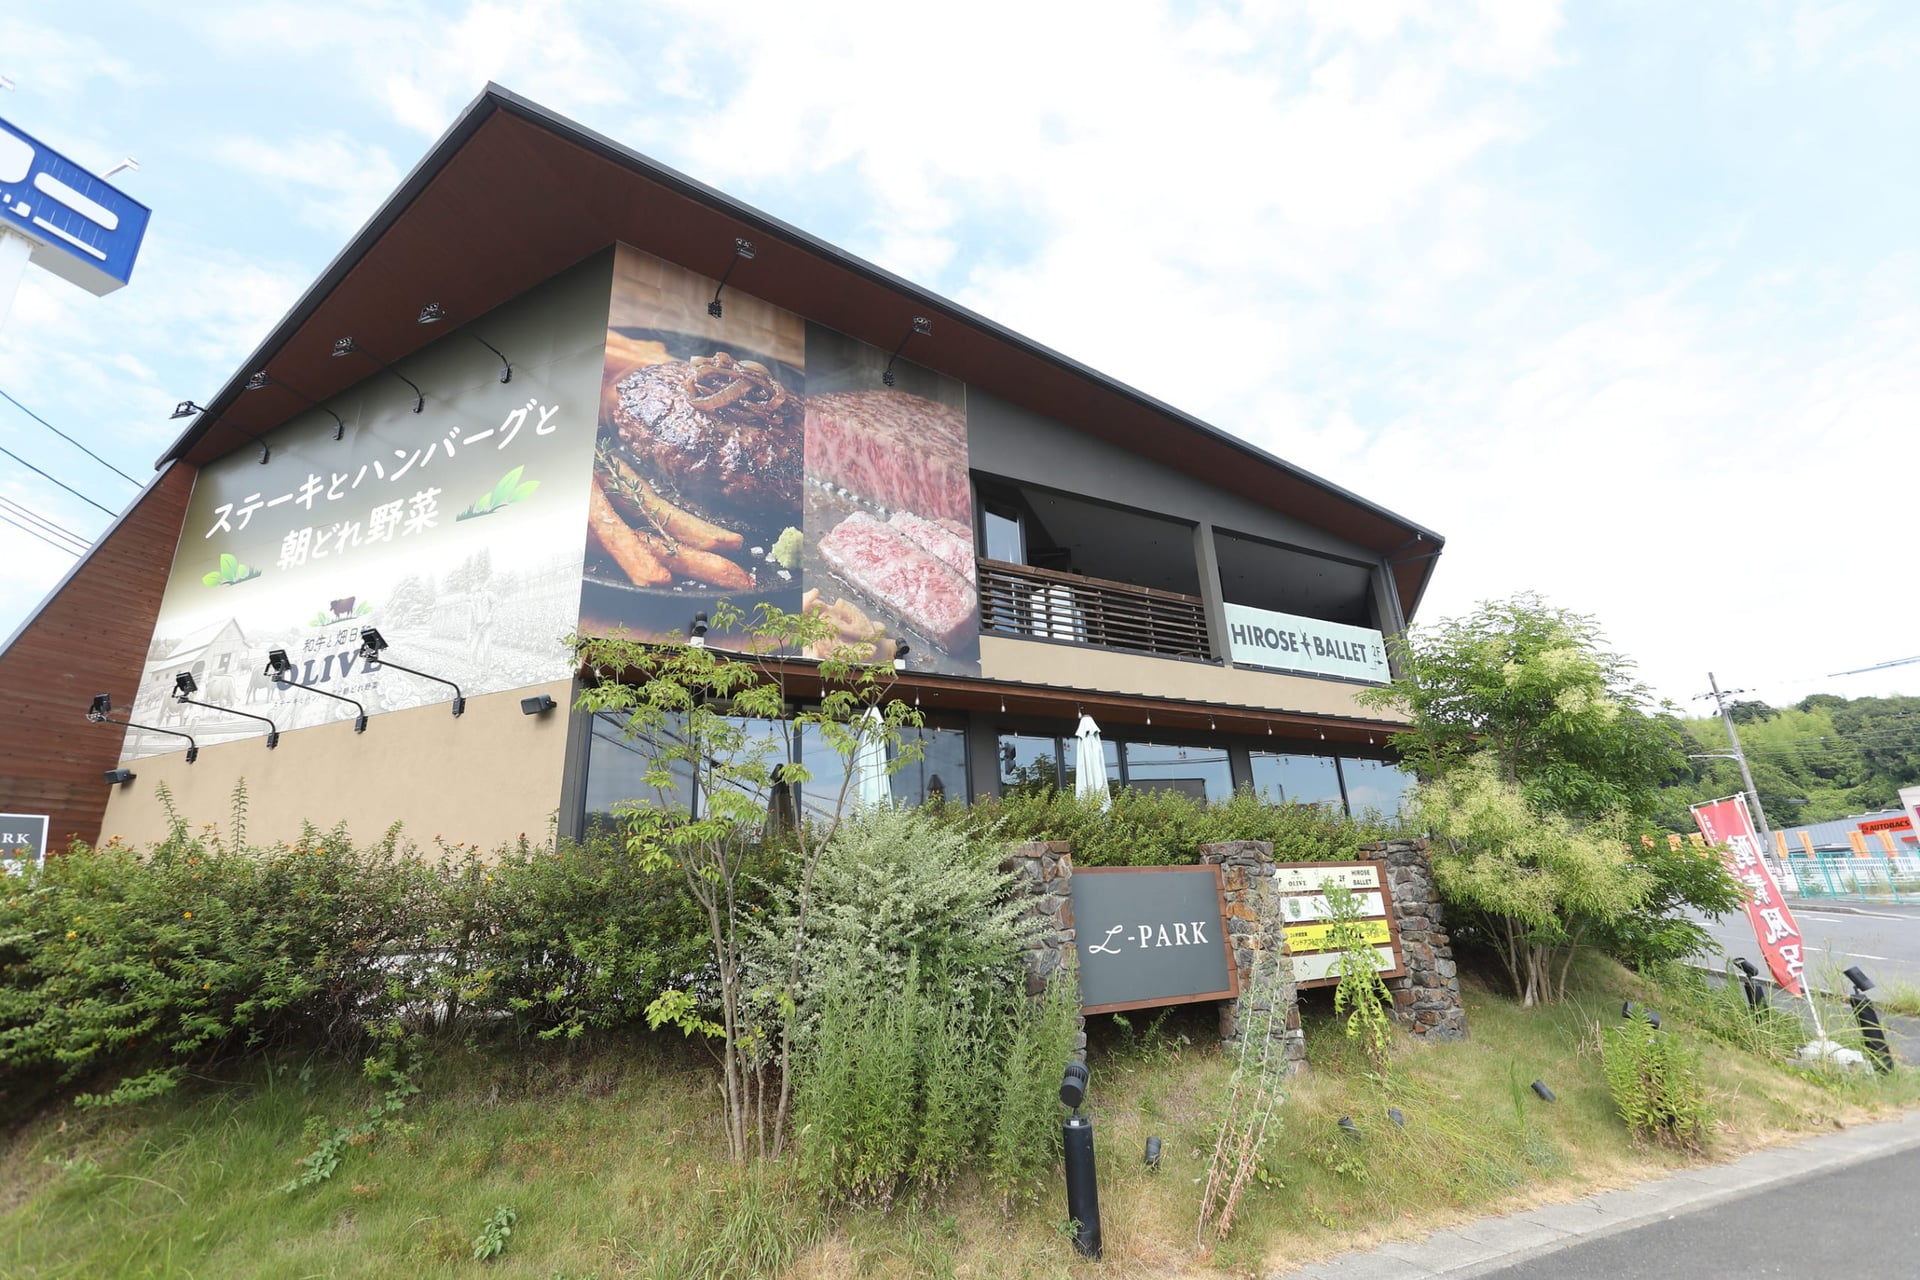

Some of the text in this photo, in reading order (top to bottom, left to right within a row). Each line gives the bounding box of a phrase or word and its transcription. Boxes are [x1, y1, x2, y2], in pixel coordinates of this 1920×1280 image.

[205, 398, 560, 539] ステーキとハンバーグと
[277, 487, 443, 571] 朝どれ野菜
[303, 625, 371, 653] 和牛と畑日
[1231, 623, 1367, 663] HIROSE BALLET
[1371, 645, 1381, 657] 2F
[1869, 820, 1911, 831] AUTOBACS
